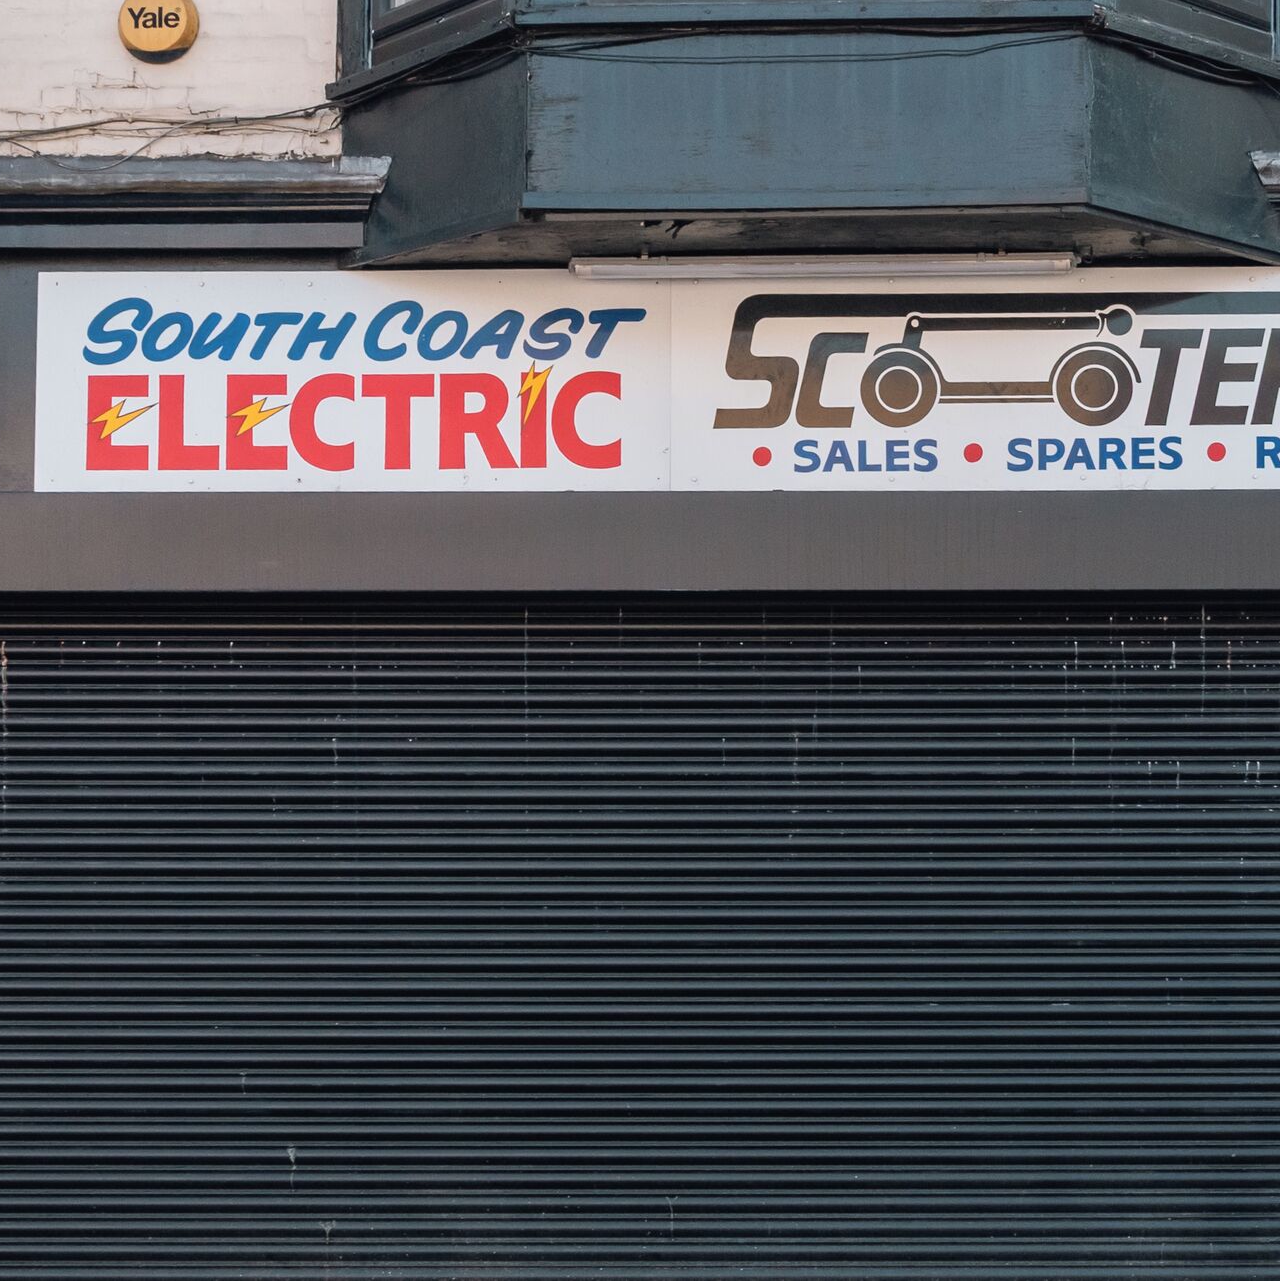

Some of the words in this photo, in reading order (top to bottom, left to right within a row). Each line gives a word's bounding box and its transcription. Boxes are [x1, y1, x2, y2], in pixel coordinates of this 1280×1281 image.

[128, 7, 180, 29] Yale
[82, 297, 356, 365] SOUTH
[362, 300, 646, 361] COAST
[85, 371, 622, 471] ELECTRIC
[792, 438, 938, 473] SALES
[1006, 435, 1183, 471] SPARES
